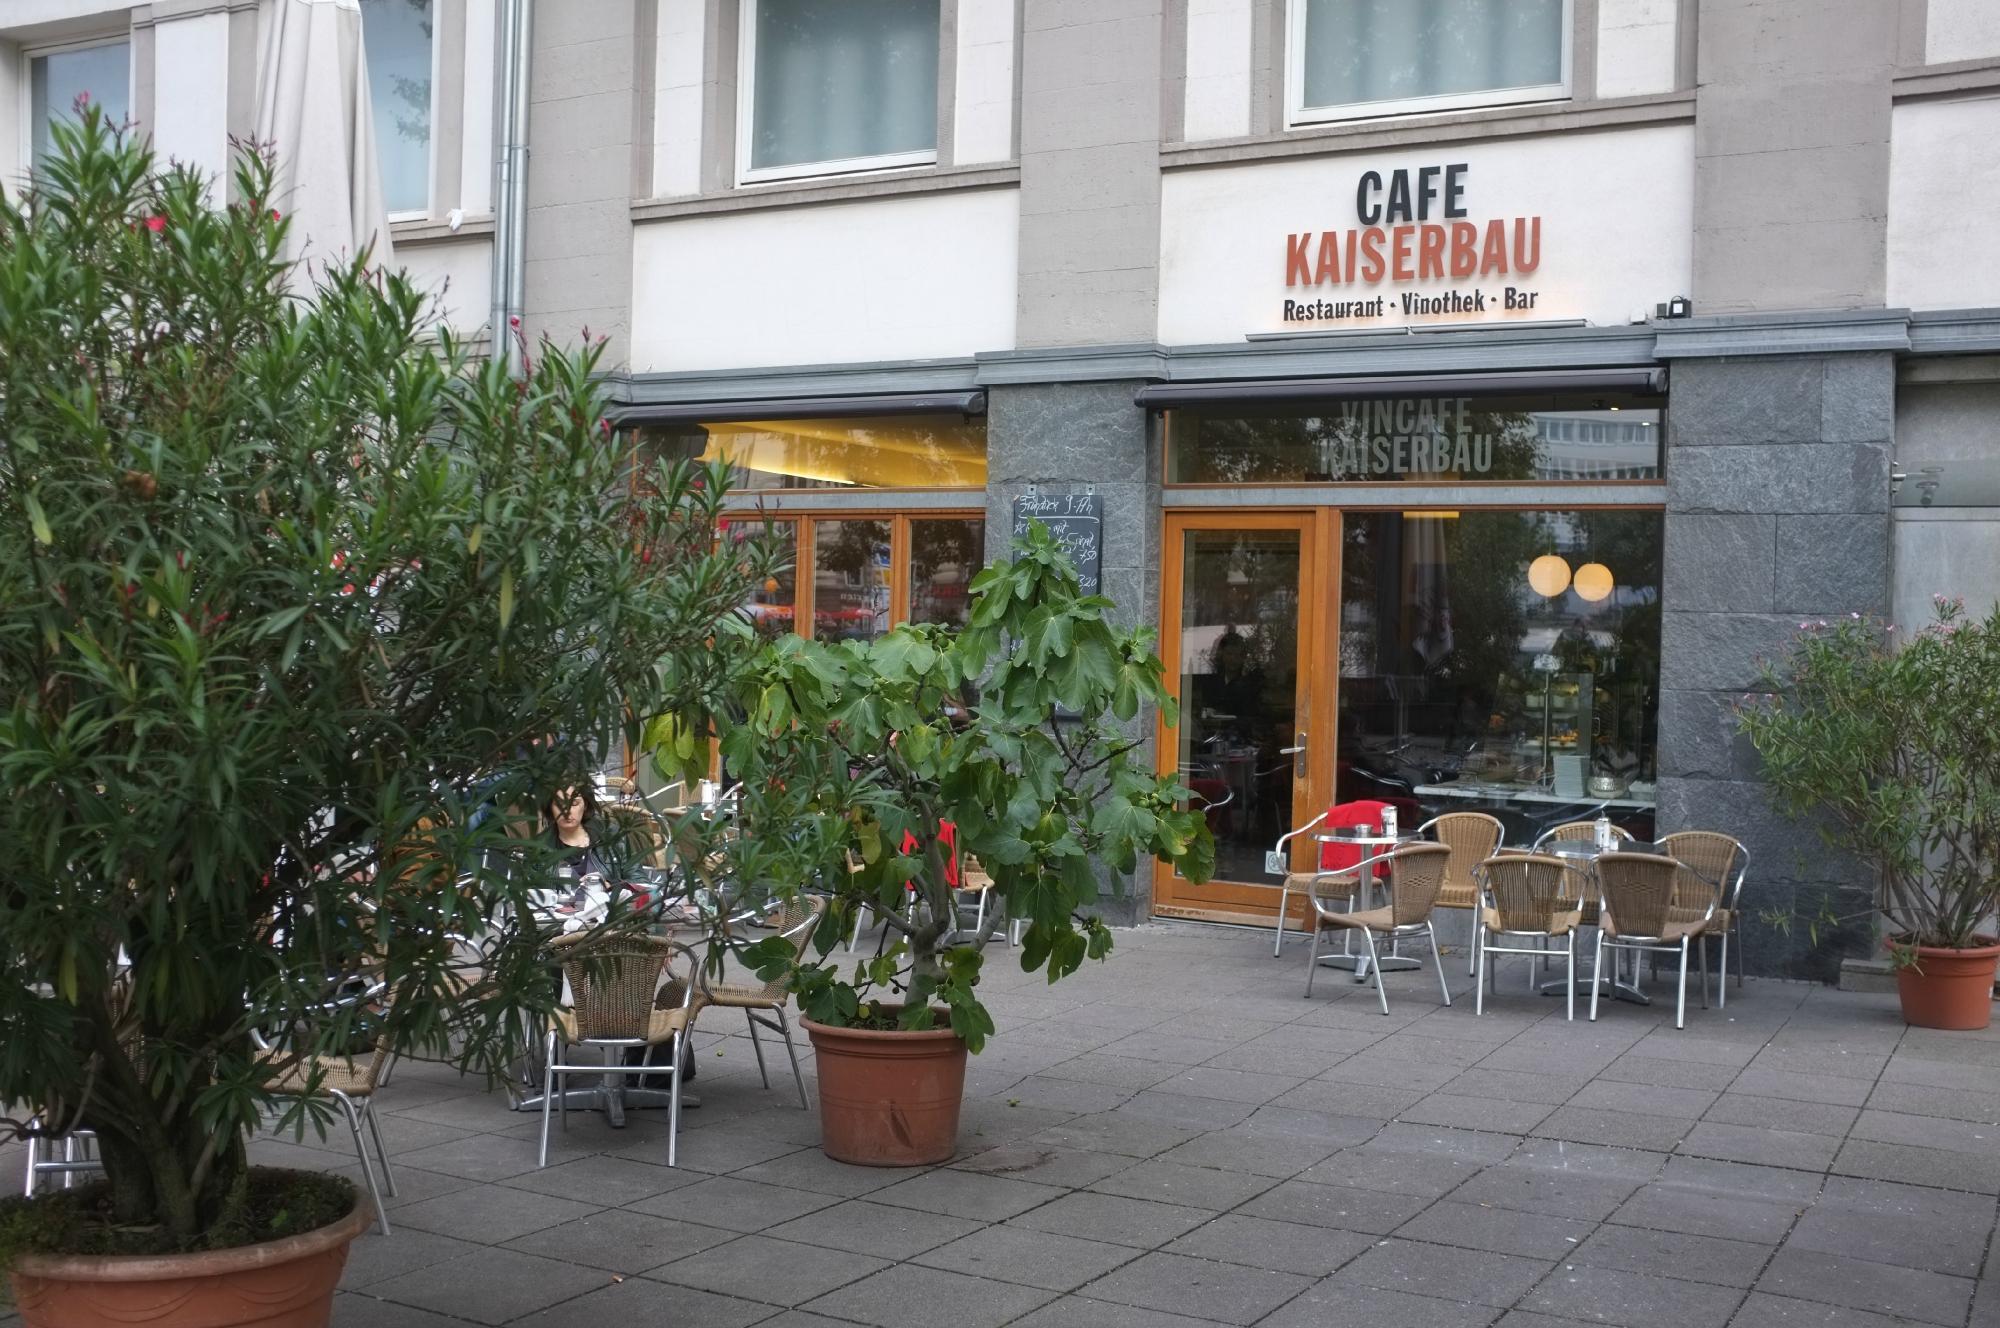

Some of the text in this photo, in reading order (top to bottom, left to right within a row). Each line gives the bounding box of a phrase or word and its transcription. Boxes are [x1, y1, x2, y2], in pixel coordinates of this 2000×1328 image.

[1357, 163, 1468, 225] CAFE
[1286, 216, 1541, 286] KAISERBAU
[1283, 286, 1538, 321] Restaurant Vinothek Bar
[1341, 397, 1472, 433] VINCAFE
[1320, 434, 1491, 474] KAISERBAU
